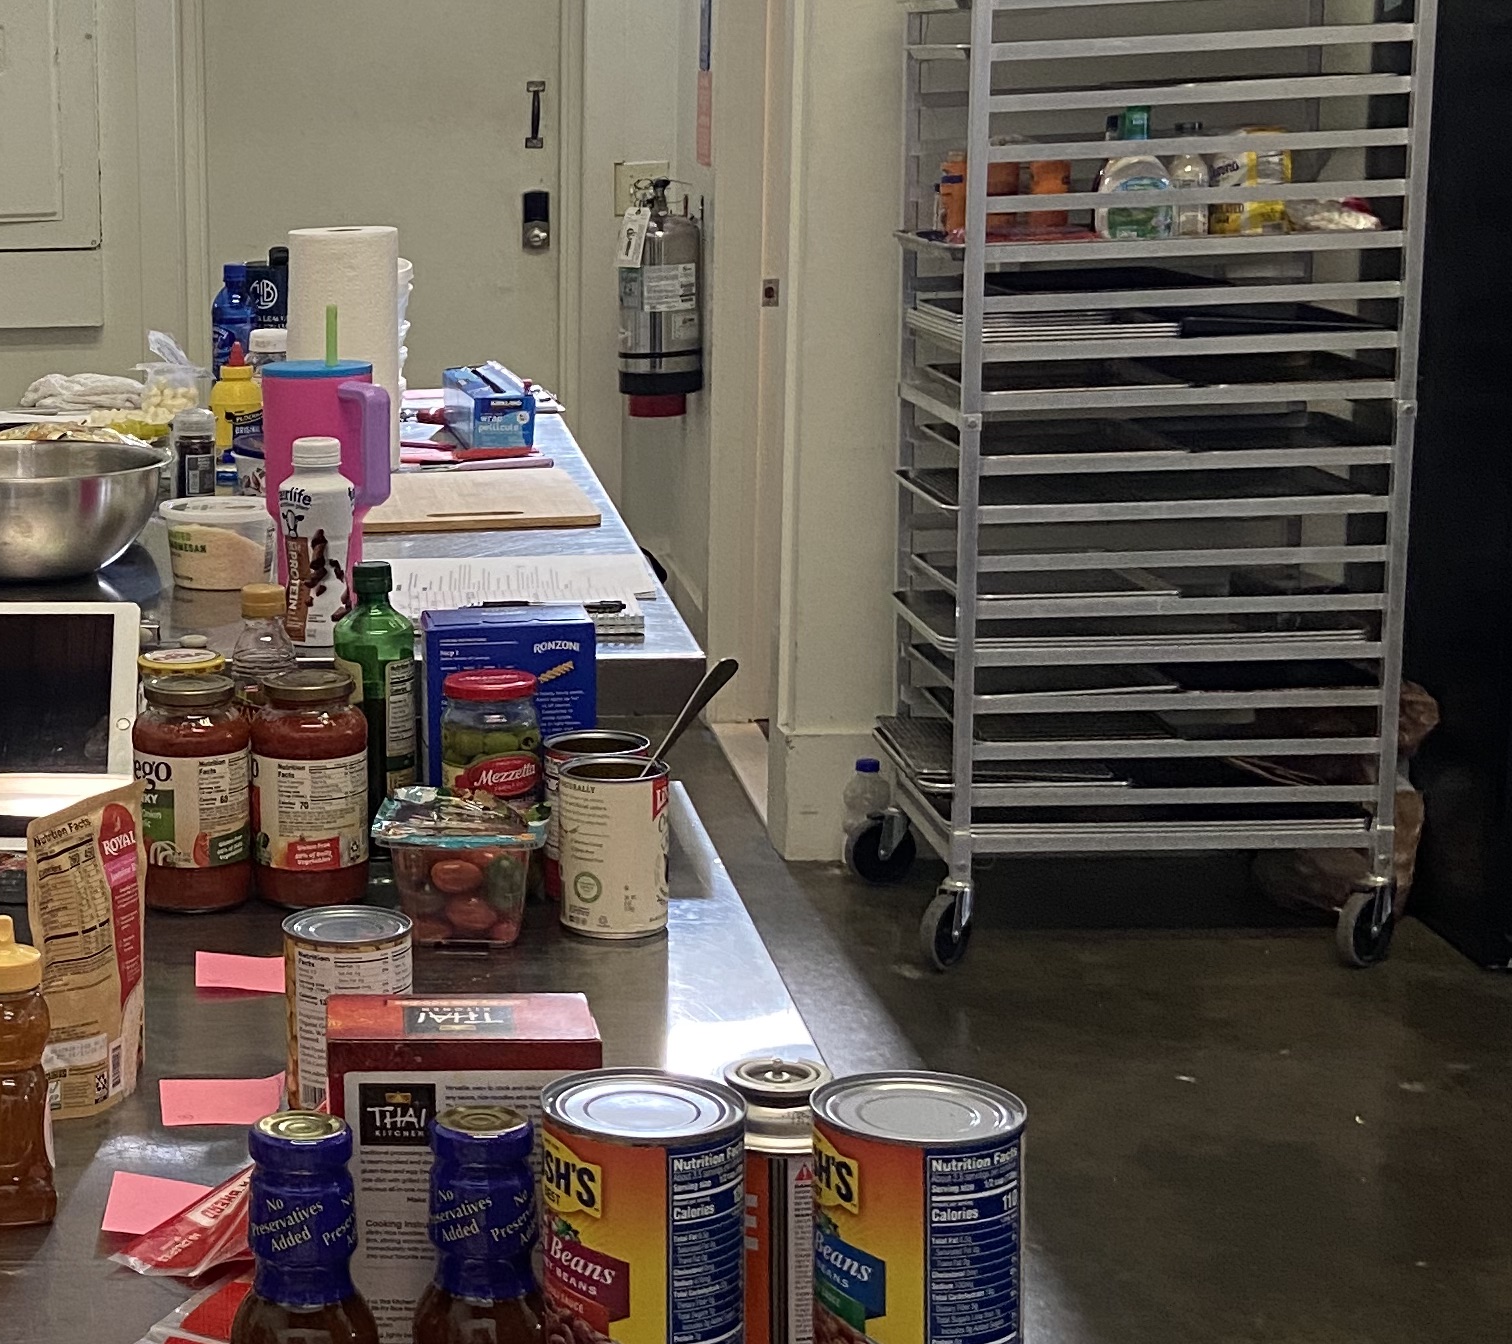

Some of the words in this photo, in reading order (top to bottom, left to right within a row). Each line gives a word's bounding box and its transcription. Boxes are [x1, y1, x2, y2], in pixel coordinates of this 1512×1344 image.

[481, 414, 504, 424] wrap
[288, 547, 301, 611] PROTEIN
[533, 640, 581, 655] RONZONI
[134, 759, 173, 792] ego
[277, 763, 306, 771] Nutrition
[277, 771, 295, 779] Facts
[474, 761, 536, 787] Mezzetta
[299, 801, 309, 810] 70
[33, 826, 69, 848] Nutrition
[68, 817, 92, 834] Facts
[101, 830, 136, 856] ROYAL
[298, 950, 331, 962] Nutrition
[298, 958, 315, 968] Facts
[417, 1011, 504, 1024] THAI
[366, 1106, 427, 1129] THAI
[374, 1129, 425, 1138] KITCHEN
[673, 1153, 726, 1173] Nutrition
[931, 1156, 992, 1173] Nutrition
[993, 1145, 1019, 1165] Facts
[544, 1149, 596, 1209] SH'S
[931, 1183, 960, 1194] Serving
[960, 1182, 976, 1192] size
[265, 1197, 284, 1213] No
[438, 1188, 455, 1204] No
[931, 1206, 980, 1222] Calories
[1001, 1187, 1019, 1212] 110
[251, 1200, 324, 1237] Preservatives
[673, 1204, 716, 1221] Calories
[365, 1219, 403, 1230] Cooking
[441, 1218, 480, 1243] Added
[270, 1224, 312, 1254] Added
[550, 1235, 616, 1286] Beans
[816, 1232, 873, 1284] Beans
[555, 1266, 598, 1296] BEANS
